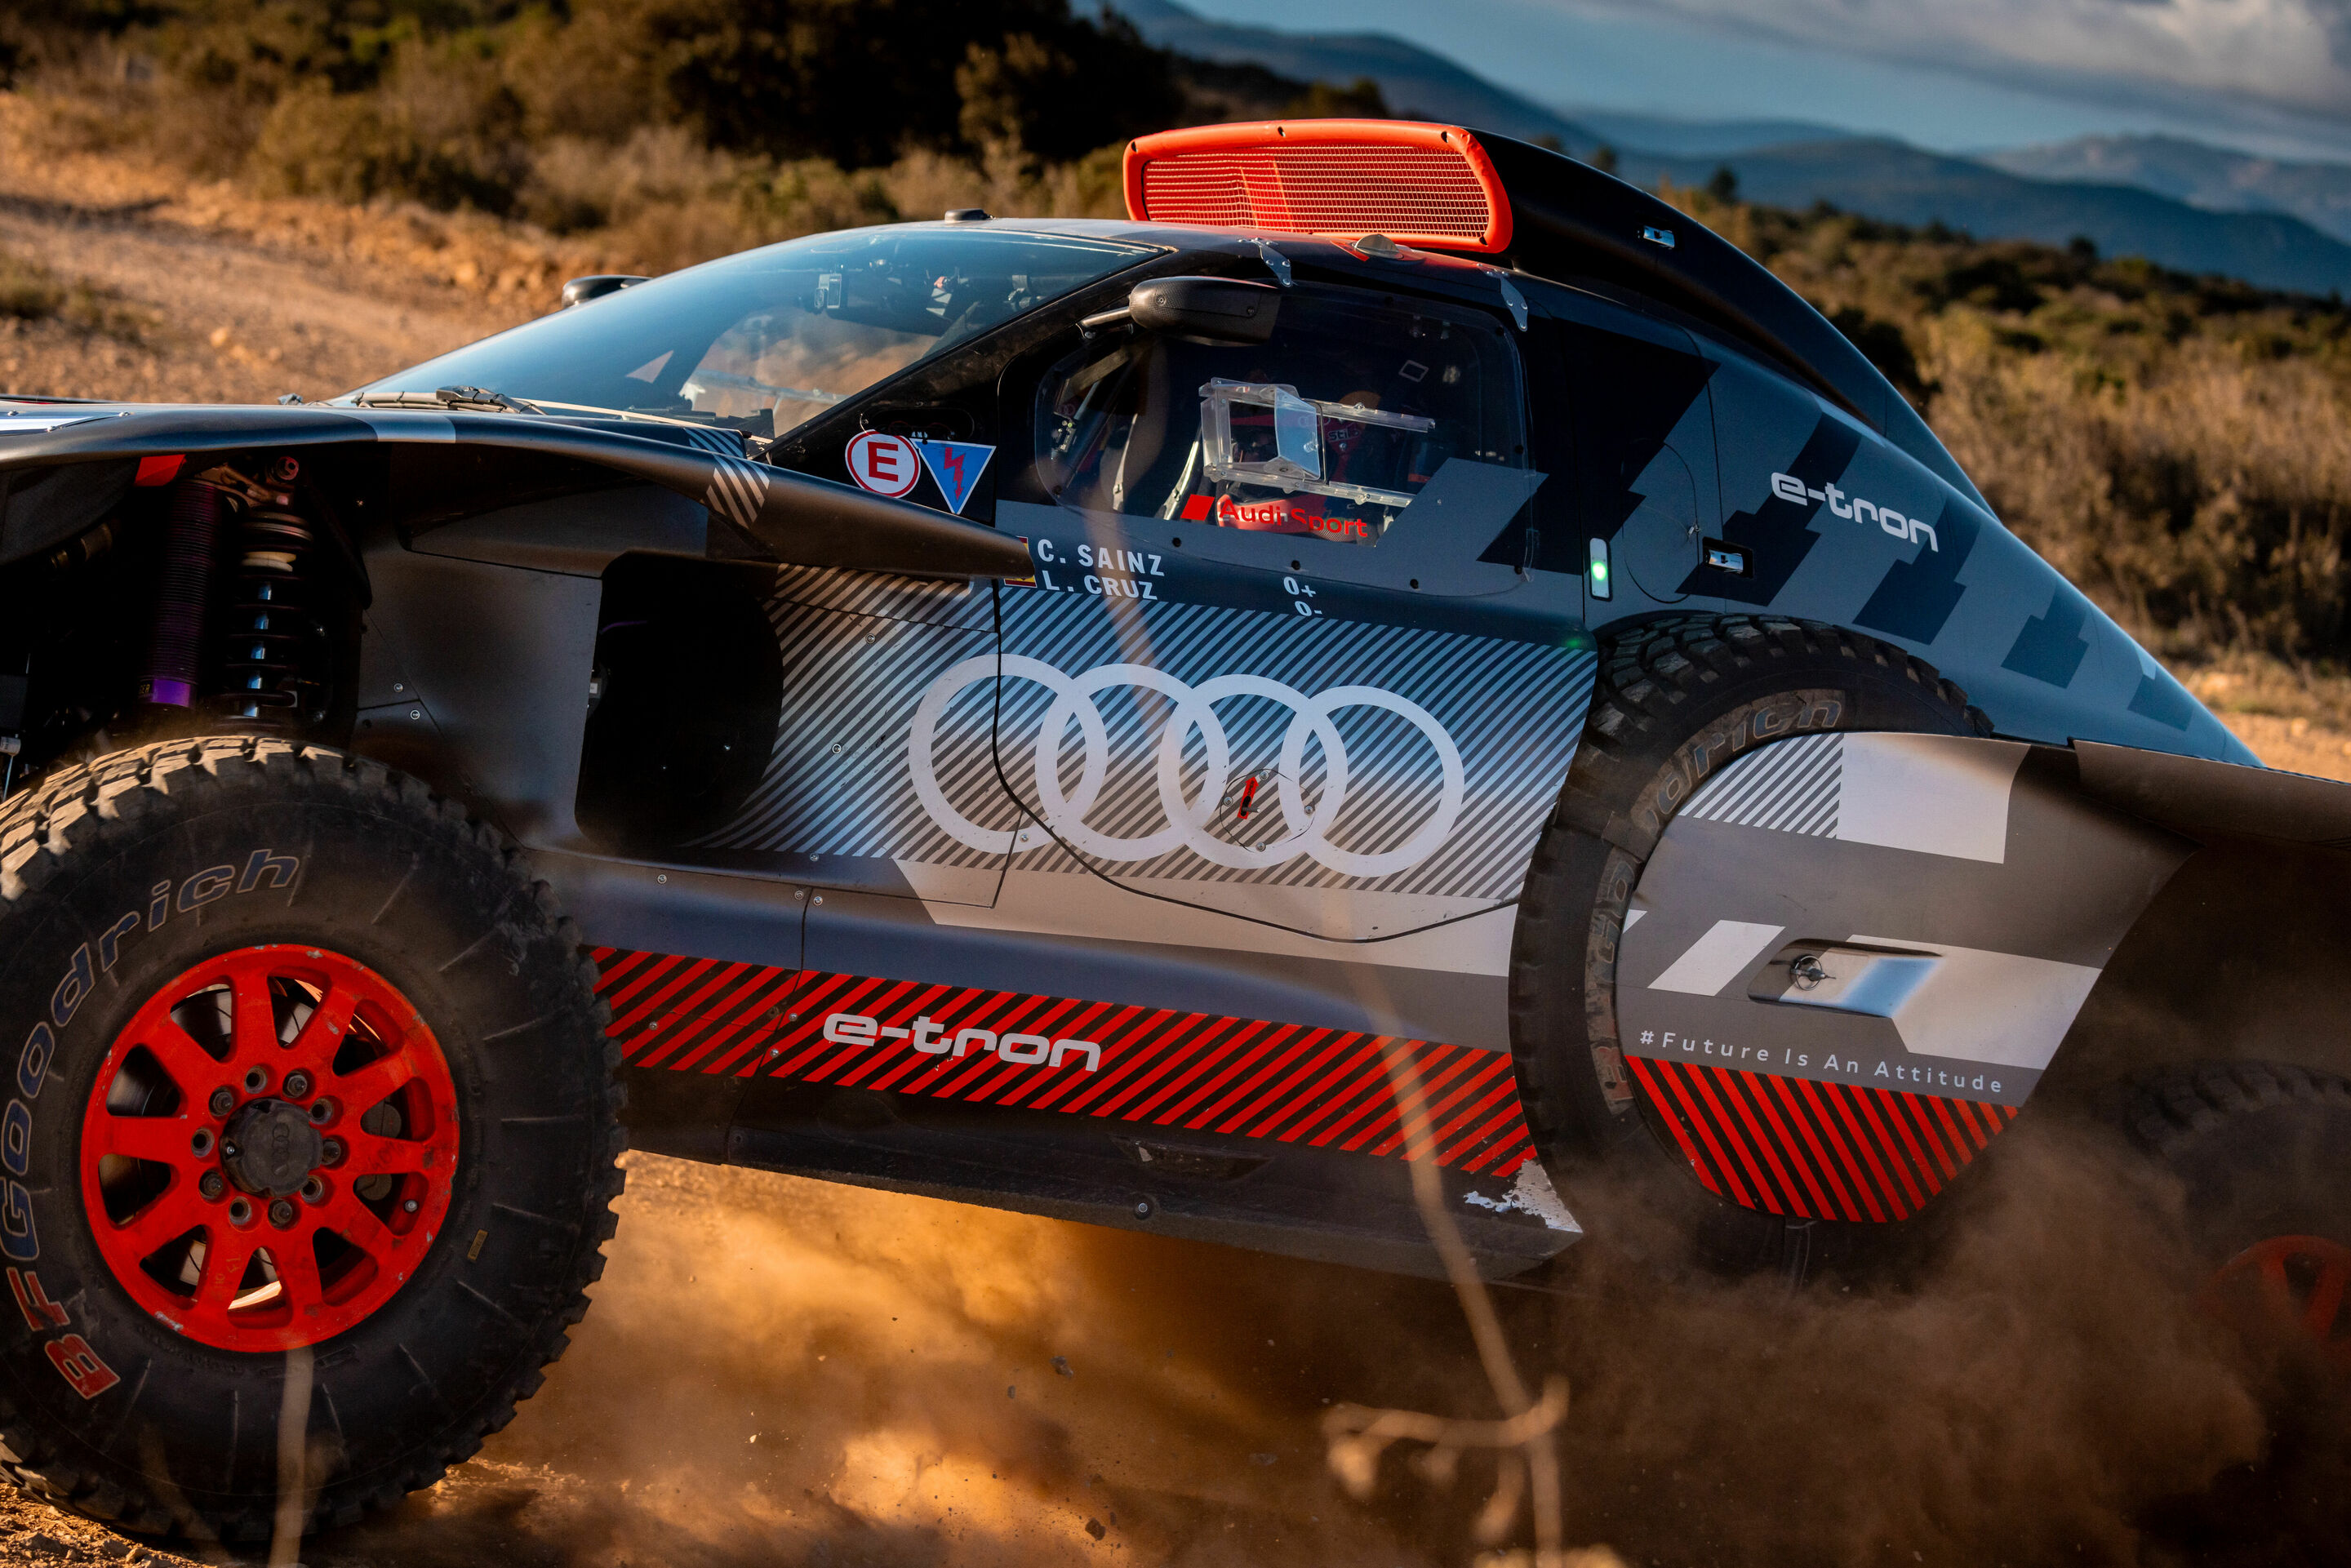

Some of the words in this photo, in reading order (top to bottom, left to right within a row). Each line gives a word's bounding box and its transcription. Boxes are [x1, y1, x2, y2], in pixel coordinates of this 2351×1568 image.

[867, 441, 899, 482] E
[1219, 498, 1282, 526] Audi
[1291, 507, 1368, 538] Sport
[1771, 472, 1939, 553] e-tron
[1037, 539, 1066, 564] C.
[1077, 544, 1165, 576] SAINZ
[1042, 570, 1074, 593] L.
[1083, 575, 1158, 601] CRUZ
[823, 1013, 1101, 1072] e-tron
[1640, 1030, 1769, 1062] #Future
[1784, 1048, 1809, 1068] Is
[1824, 1054, 1859, 1073] An
[1874, 1061, 2002, 1093] Attitude
